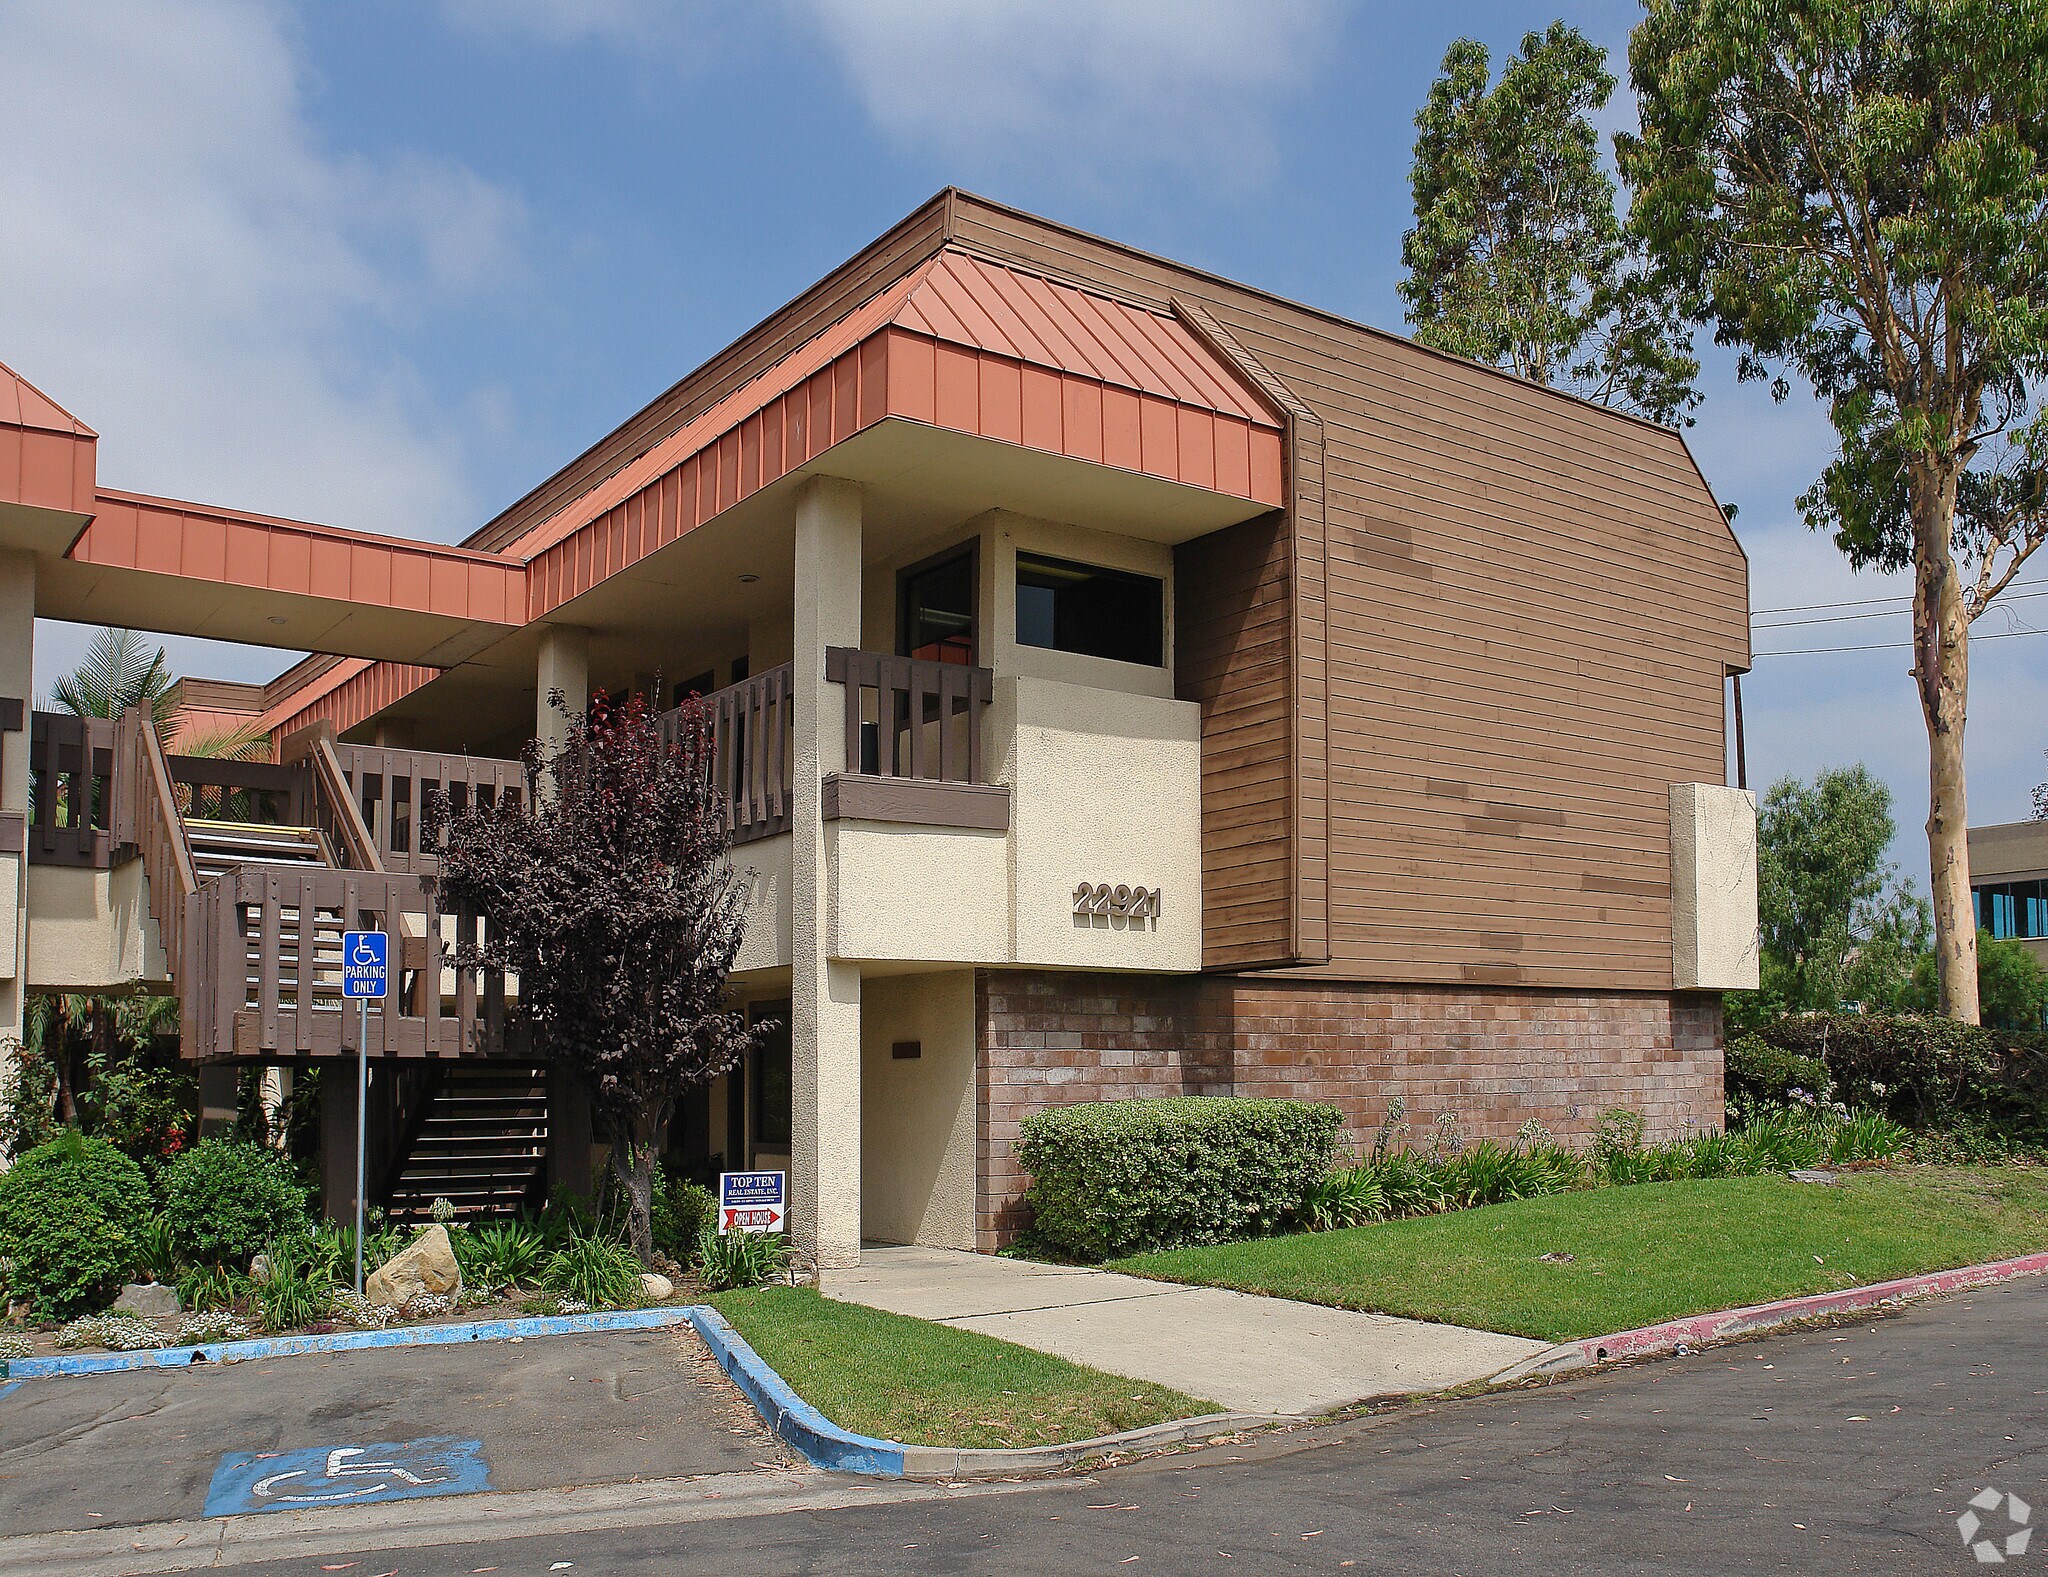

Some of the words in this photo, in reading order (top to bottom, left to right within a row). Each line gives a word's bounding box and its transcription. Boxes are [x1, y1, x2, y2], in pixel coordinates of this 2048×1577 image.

[1074, 882, 1160, 917] 22921
[345, 965, 385, 979] PARKING
[353, 980, 377, 994] ONLY
[731, 1177, 753, 1188] TOP
[754, 1176, 776, 1187] TEN
[734, 1213, 750, 1226] OPEN
[751, 1211, 771, 1225] HOUSE
